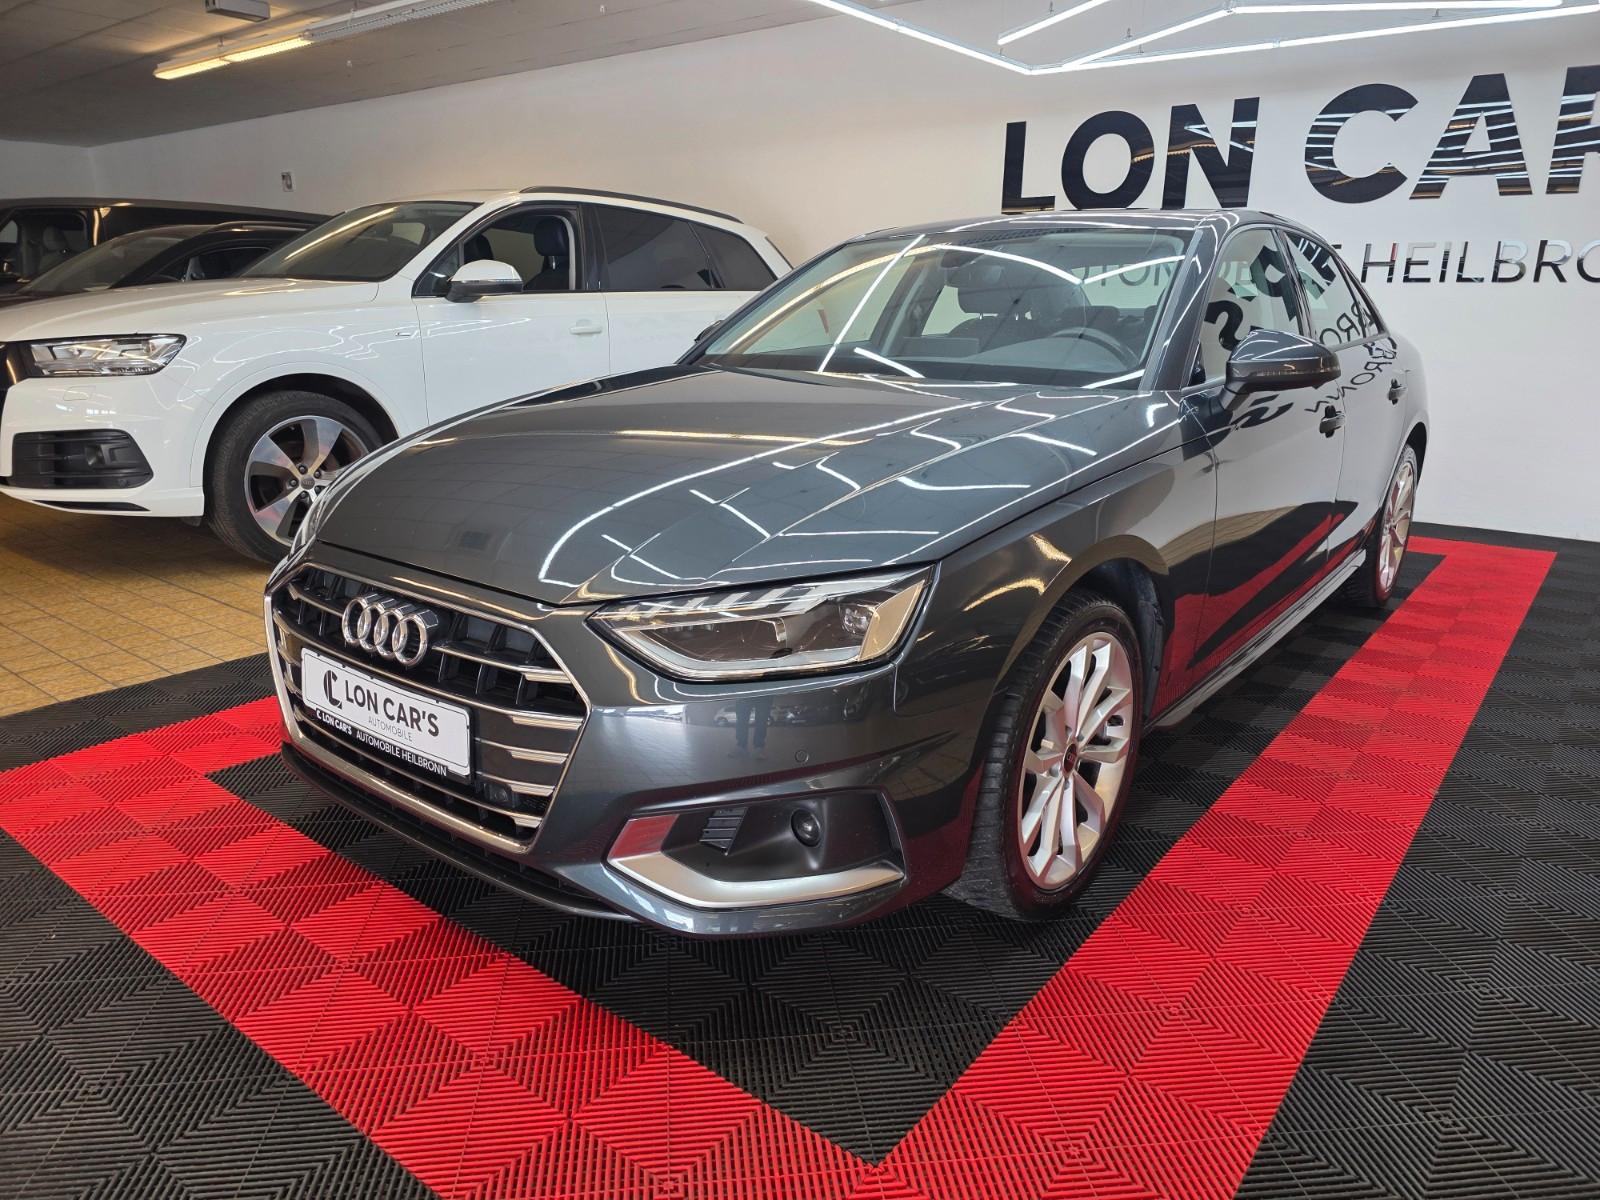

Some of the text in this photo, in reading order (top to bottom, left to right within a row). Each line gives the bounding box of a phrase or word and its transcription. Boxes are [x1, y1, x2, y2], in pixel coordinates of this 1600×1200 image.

[1001, 97, 1261, 214] LON
[345, 679, 440, 737] LON CAR'S
[368, 716, 413, 742] AUTOMOBILE
[322, 712, 335, 726] LON
[356, 730, 401, 758] AUTOMOBILE
[401, 749, 448, 777] HEILBRONN
